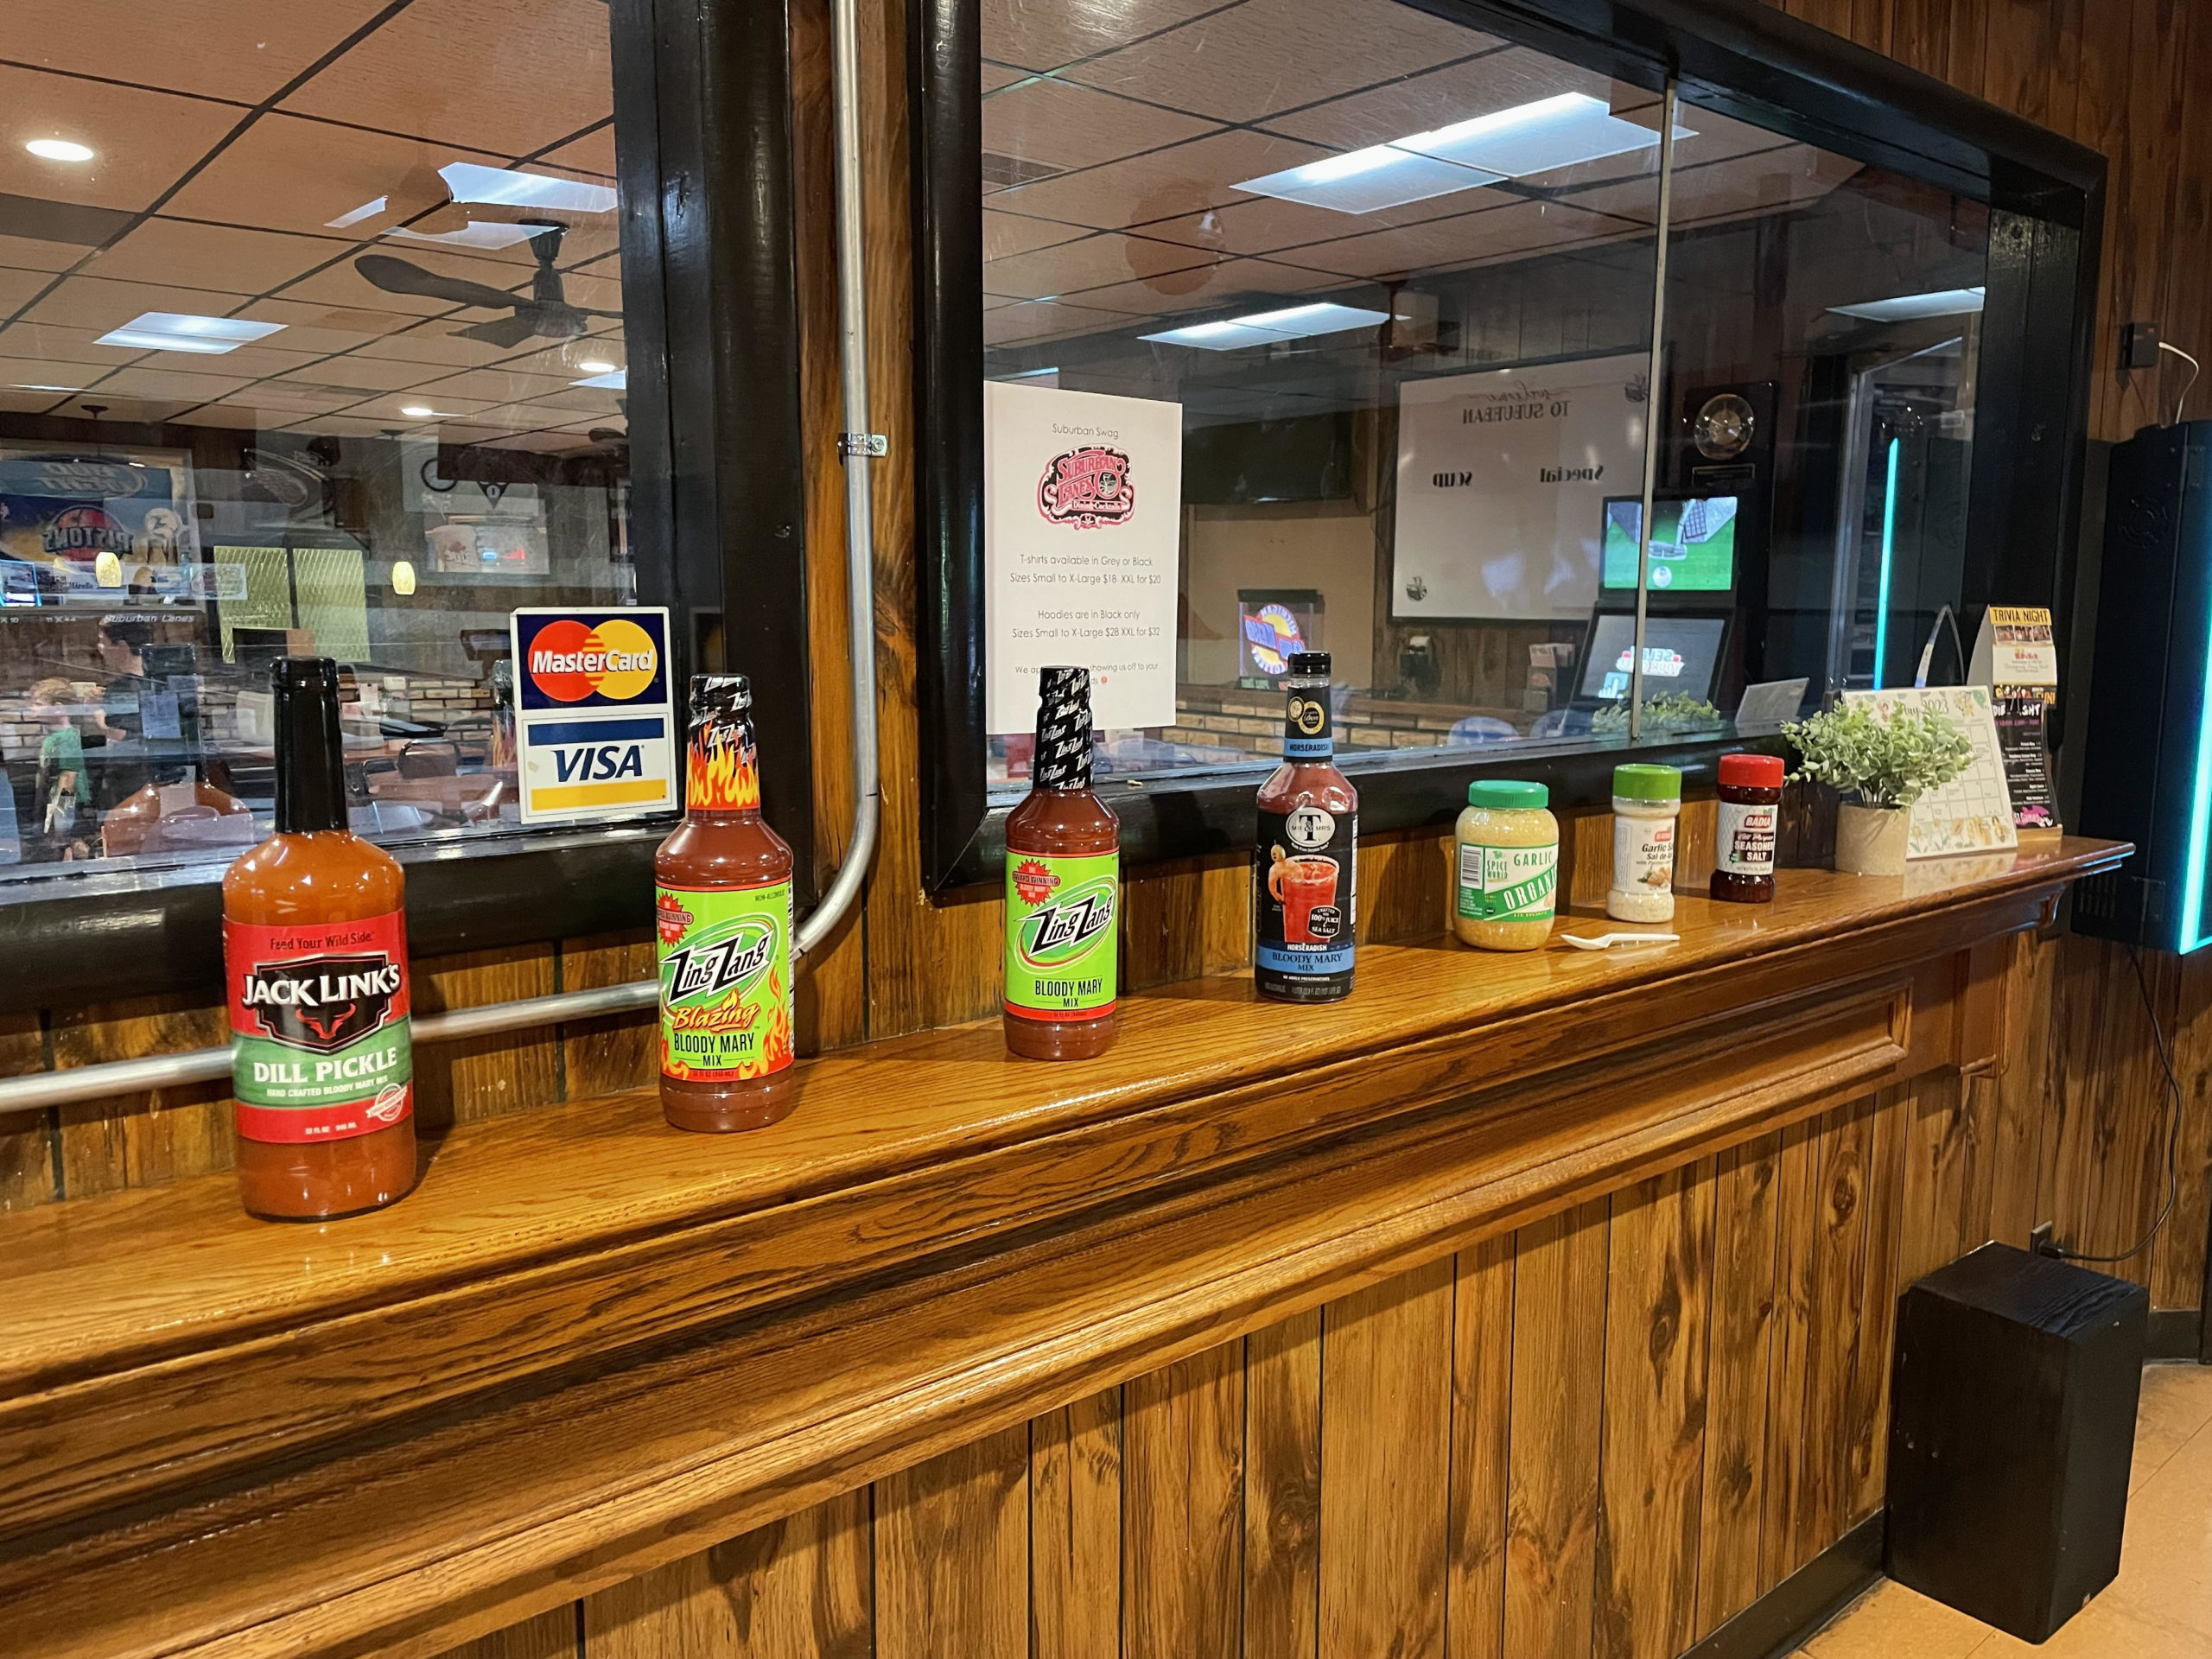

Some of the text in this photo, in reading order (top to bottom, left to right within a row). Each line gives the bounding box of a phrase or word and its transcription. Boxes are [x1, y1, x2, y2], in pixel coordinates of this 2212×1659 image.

[1052, 423, 1119, 439] Suburban Swag
[1020, 554, 1047, 565] T-shirts
[1051, 555, 1090, 566] available
[1091, 556, 1099, 565] in
[1101, 556, 1120, 568] Grey
[1133, 556, 1153, 567] Black
[1010, 573, 1161, 586] Sizes Small to X-Large $18 XXL for $20
[1038, 610, 1073, 620] Hoodies
[1090, 610, 1098, 620] in
[1100, 609, 1122, 620] Black
[1124, 610, 1141, 620] only
[1993, 609, 2049, 623] TRIVIA NIGHT
[1012, 626, 1160, 639] Sizes Small to X-Large $28 XXL for $32
[532, 649, 653, 674] MasterCard
[1015, 666, 1029, 675] We
[1127, 663, 1137, 671] off
[1138, 662, 1145, 671] to
[1145, 662, 1159, 672] your
[551, 745, 643, 783] VISA
[1745, 817, 1771, 827] BADIA
[1642, 843, 1667, 852] Garlic
[1514, 851, 1552, 866] GARLIC
[1746, 852, 1767, 861] SALT
[1487, 860, 1508, 871] SPICE
[1503, 865, 1556, 910] ORGANI
[270, 938, 294, 950] Feed
[297, 938, 322, 950] Your
[325, 935, 348, 949] Wild
[1287, 943, 1327, 951] HORSERADISH
[1272, 952, 1343, 963] BLOODY MARY
[243, 963, 401, 1007] JACK LINK'S
[1035, 978, 1103, 996] BLOODY MARY
[1063, 998, 1079, 1007] MIX
[674, 1005, 760, 1031] Blazing
[674, 1032, 754, 1053] BLOODY MARY
[254, 1047, 397, 1084] DILL PICKLE
[702, 1055, 721, 1067] MIX
[288, 1089, 322, 1097] CRAFTED
[323, 1083, 353, 1095] BLOODY
